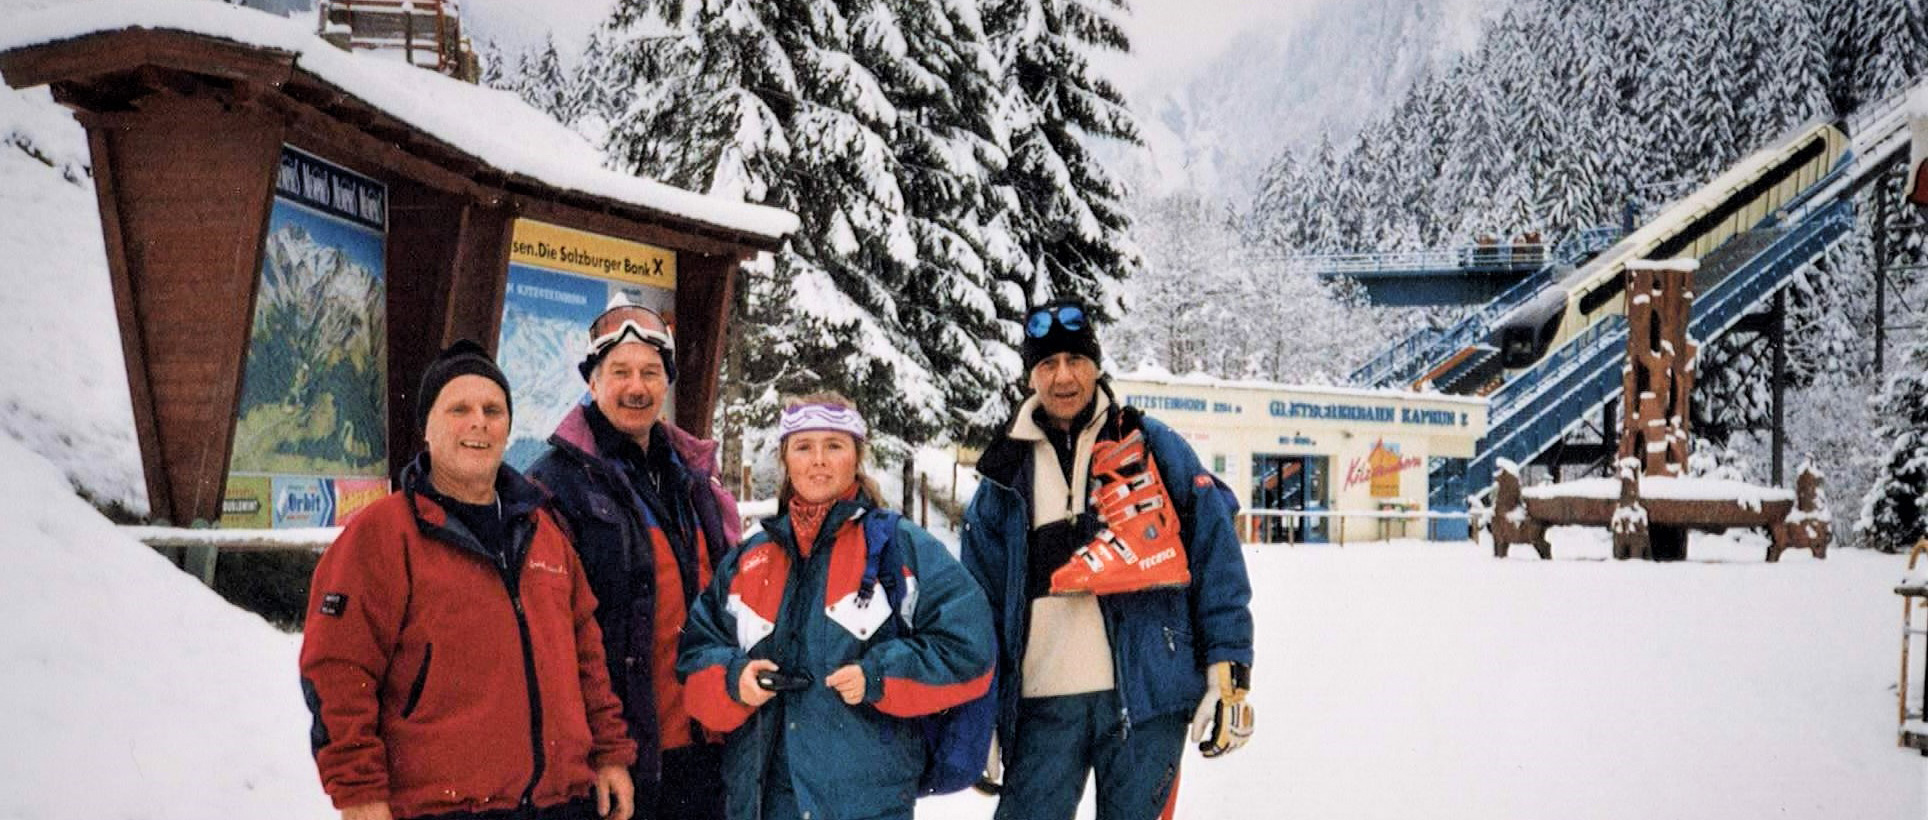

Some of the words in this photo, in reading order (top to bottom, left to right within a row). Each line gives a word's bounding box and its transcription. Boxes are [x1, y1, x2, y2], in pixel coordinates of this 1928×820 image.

[560, 246, 621, 274] Salzburger
[624, 258, 650, 276] Bank
[1269, 400, 1395, 423] GLETSCHERBAHN
[1402, 406, 1455, 426] KAPRUN
[288, 492, 321, 512] Orbit
[1138, 547, 1177, 571] TECNICA
